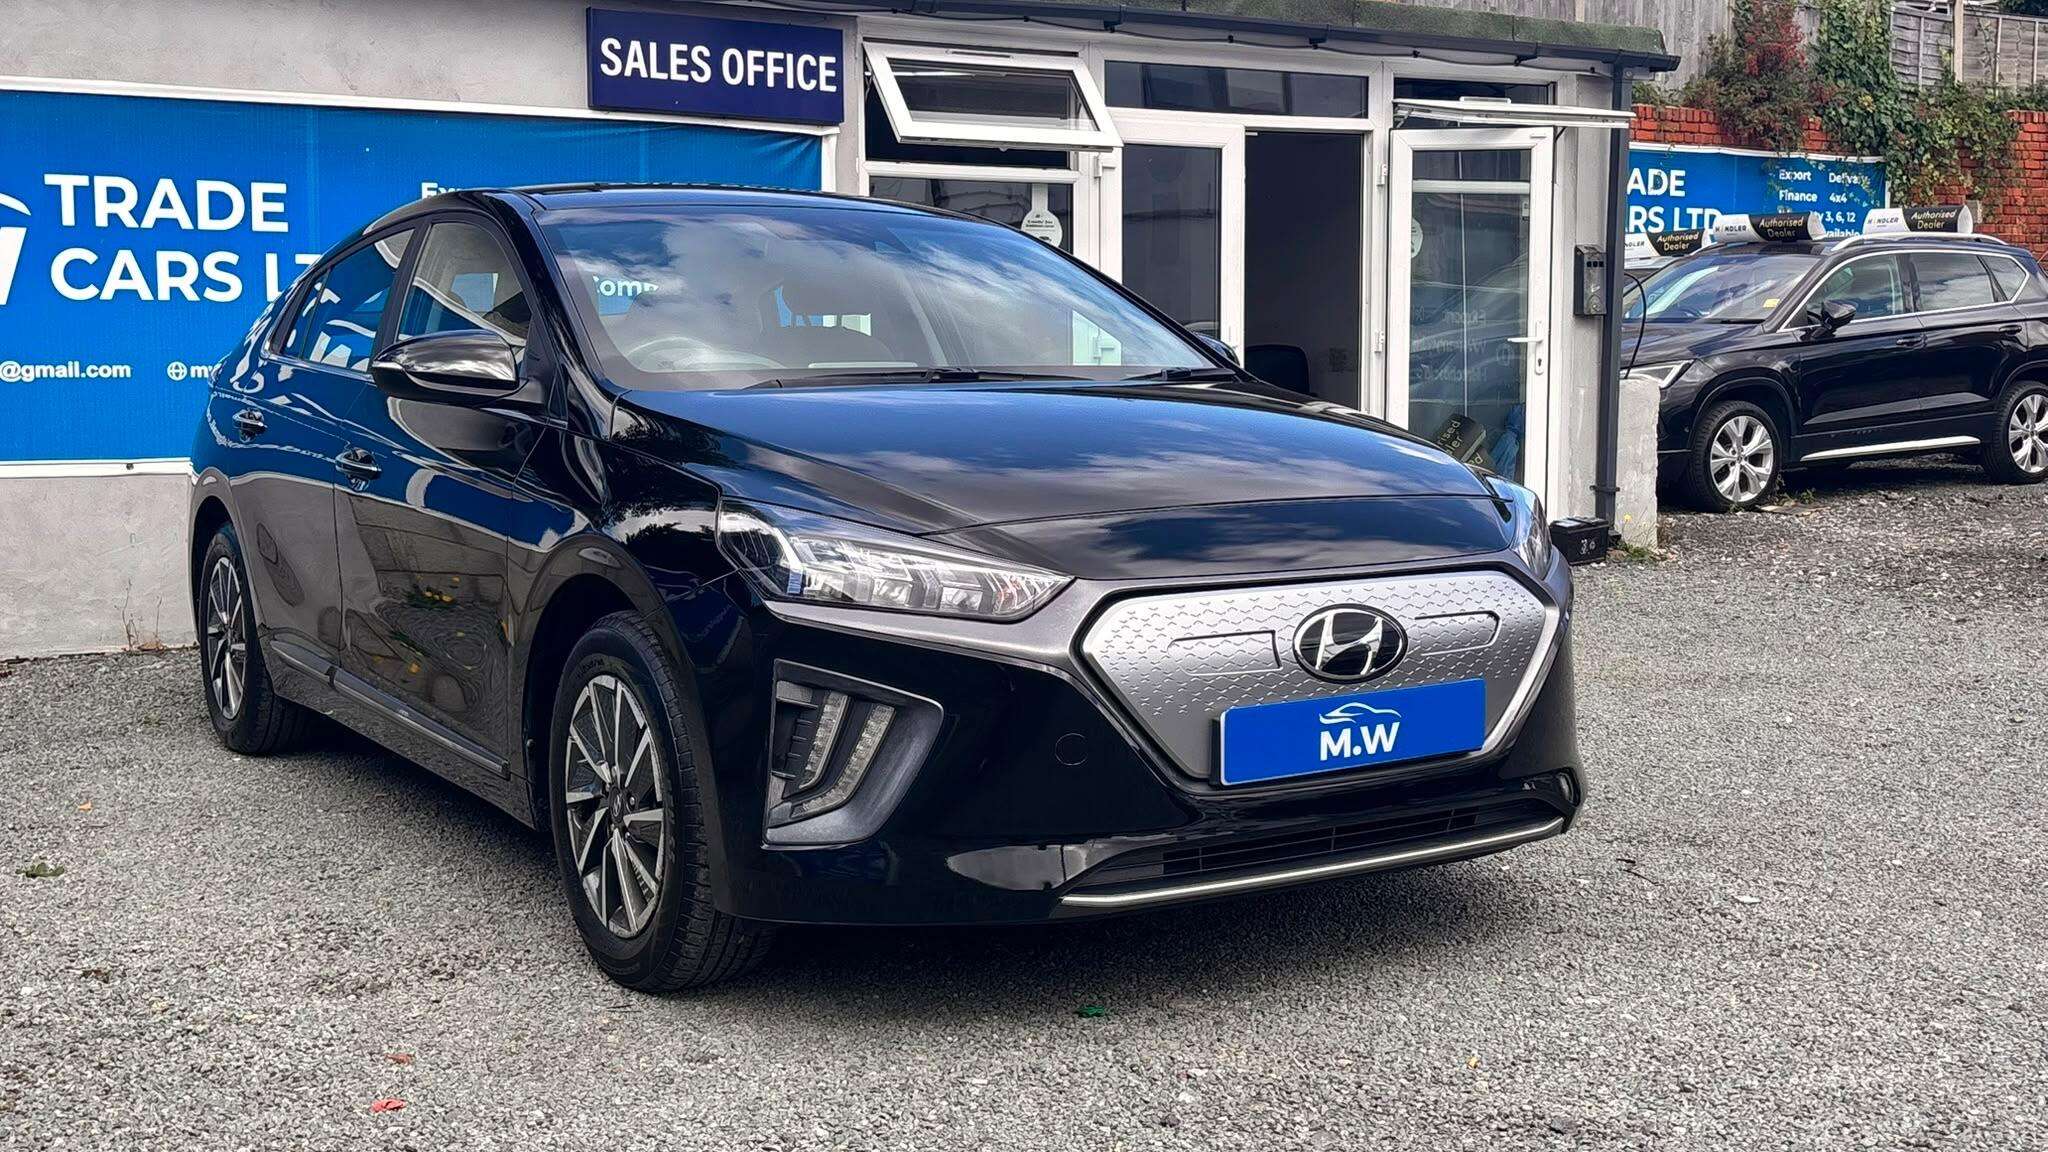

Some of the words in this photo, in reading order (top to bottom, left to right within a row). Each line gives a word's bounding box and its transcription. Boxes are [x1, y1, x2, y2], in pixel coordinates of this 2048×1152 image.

[600, 38, 712, 84] SALES
[721, 48, 837, 93] OFFICE
[1779, 189, 1818, 202] Finance
[1829, 192, 1848, 203] 4x4
[44, 173, 289, 233] TRADE
[1626, 205, 1665, 234] RS
[1846, 212, 1856, 222] 12
[1911, 210, 1957, 221] Authorised
[1759, 216, 1805, 229] Authorised
[1917, 220, 1945, 230] Dealer
[1657, 232, 1700, 242] Authorised
[1767, 228, 1797, 238] Dealer
[1664, 243, 1690, 251] Dealer
[50, 247, 242, 303] CARS
[1320, 721, 1401, 761] M.W
